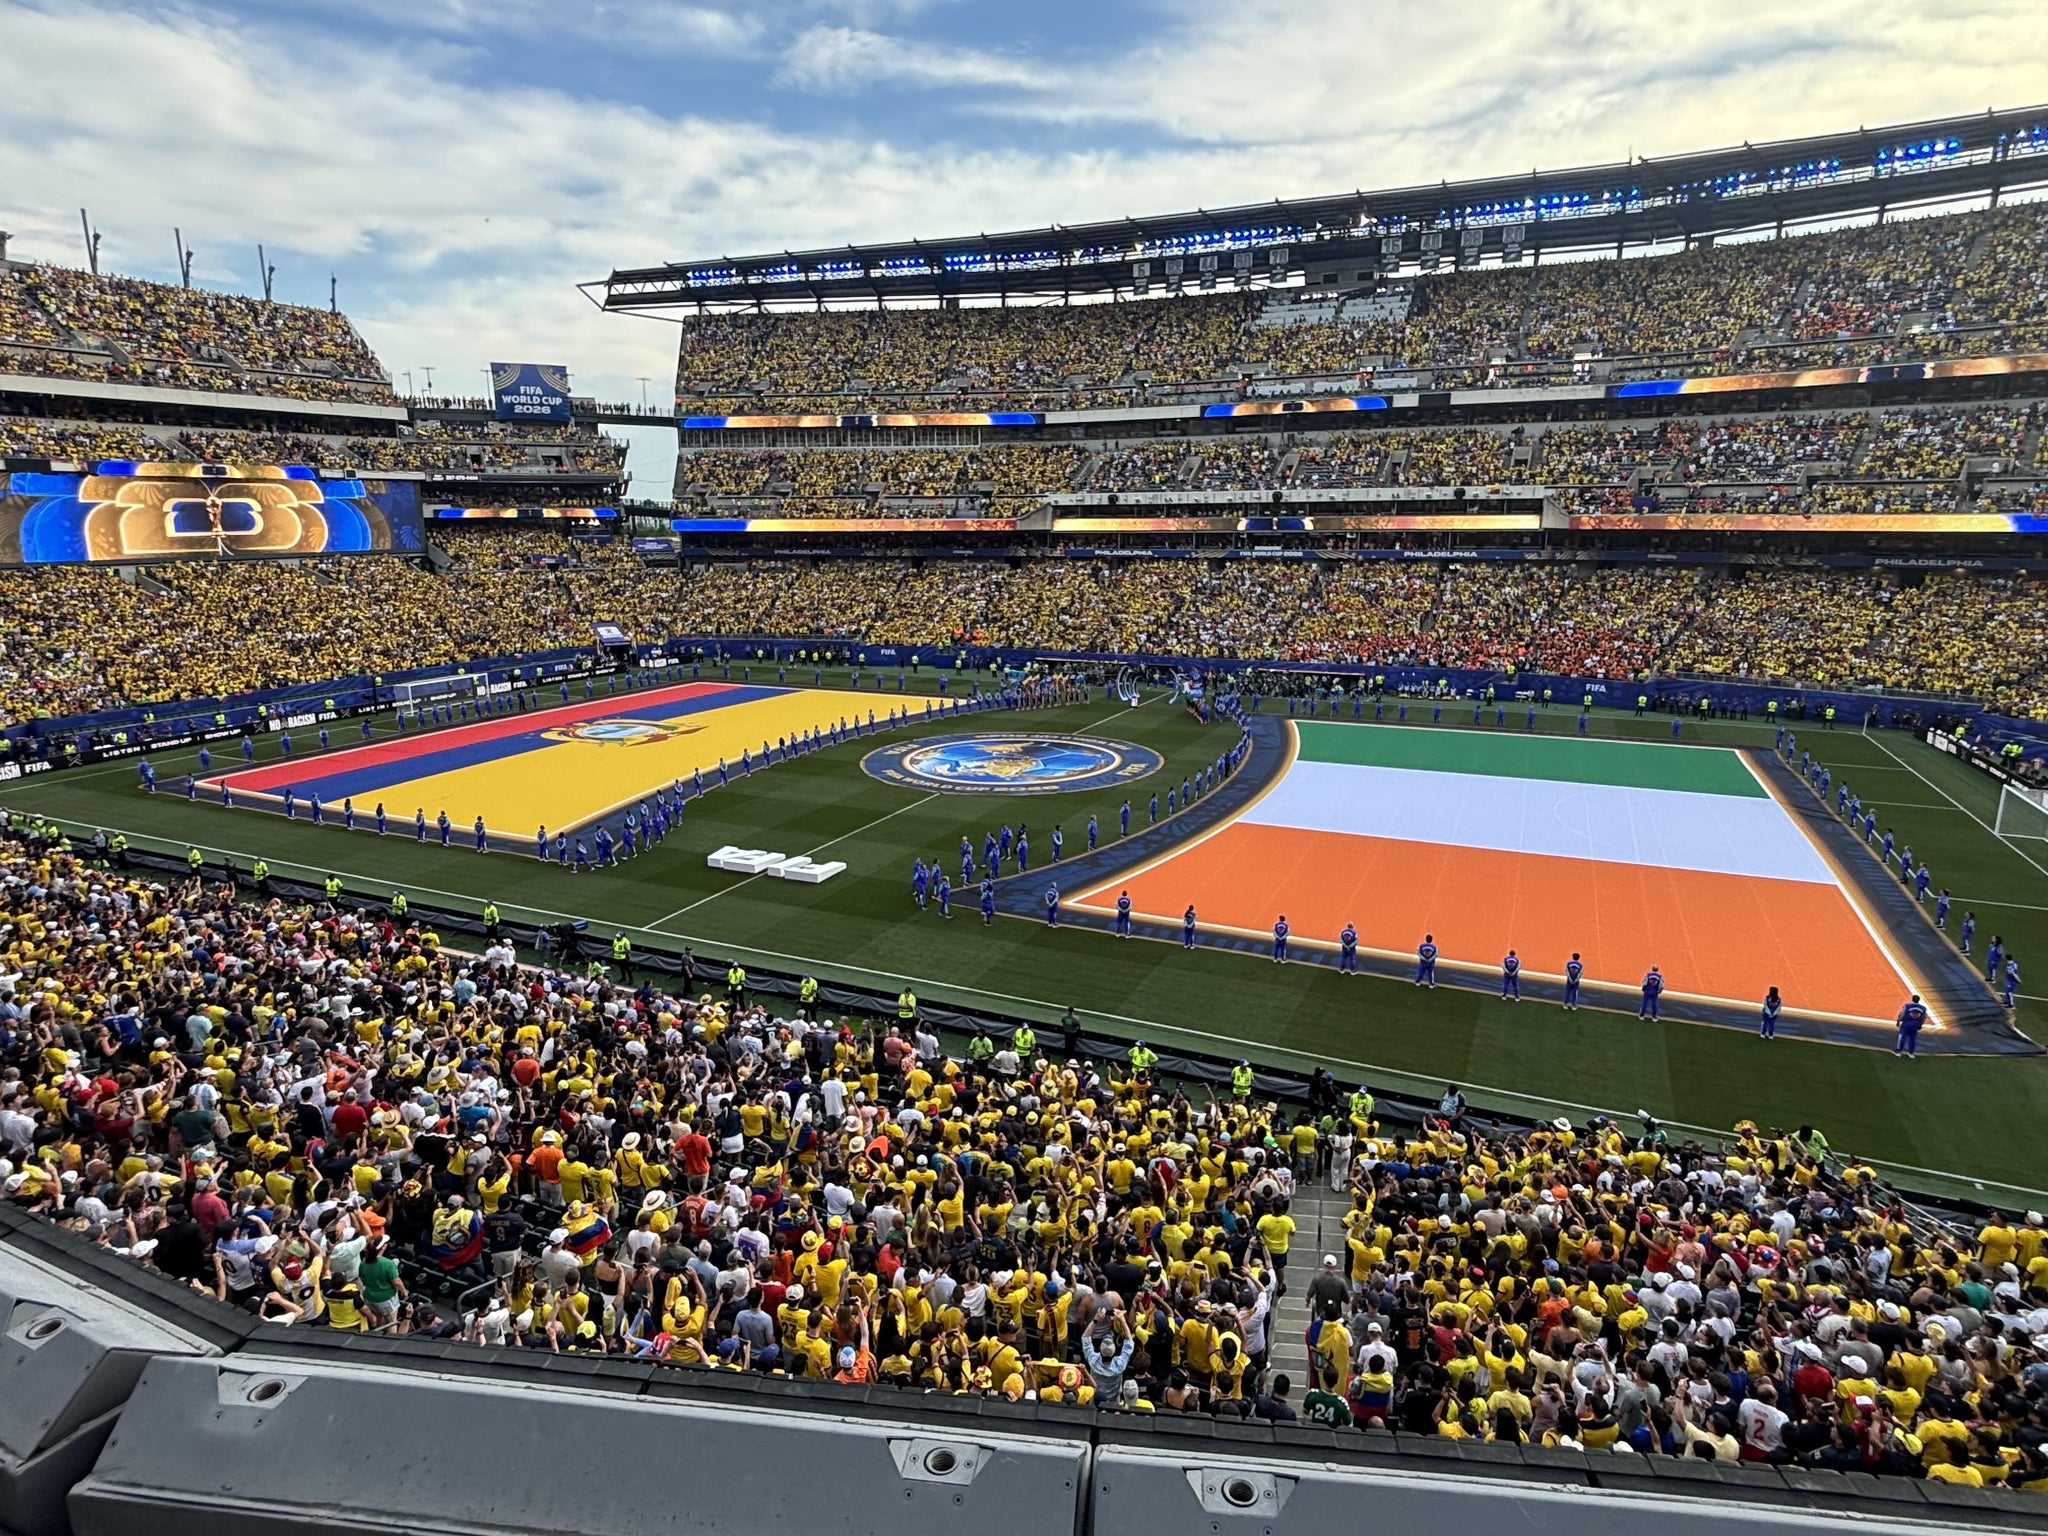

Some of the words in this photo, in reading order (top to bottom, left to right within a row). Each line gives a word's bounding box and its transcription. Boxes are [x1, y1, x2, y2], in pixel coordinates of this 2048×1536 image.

[519, 386, 543, 396] FIFA
[502, 395, 540, 404] WORLD
[541, 397, 563, 406] CUP
[514, 404, 551, 414] 2026
[1875, 558, 1983, 567] PHILADELPHIA
[555, 664, 568, 672] FIFA
[490, 681, 512, 694] RACISM
[513, 681, 528, 689] FIFA
[1585, 683, 1607, 693] FIFA
[268, 719, 281, 732] NO
[288, 712, 317, 728] RACISM
[318, 711, 338, 721] FIFA
[102, 746, 141, 758] LISTEN
[150, 739, 179, 749] STAND
[204, 730, 229, 740] SHOW
[24, 761, 51, 774] FIFA
[1113, 763, 1149, 777] FIFA
[902, 777, 954, 789] WORLD
[689, 1208, 697, 1225] 8
[781, 1321, 798, 1341] 23
[1314, 1402, 1335, 1422] 24
[1753, 1418, 1765, 1441] 2
